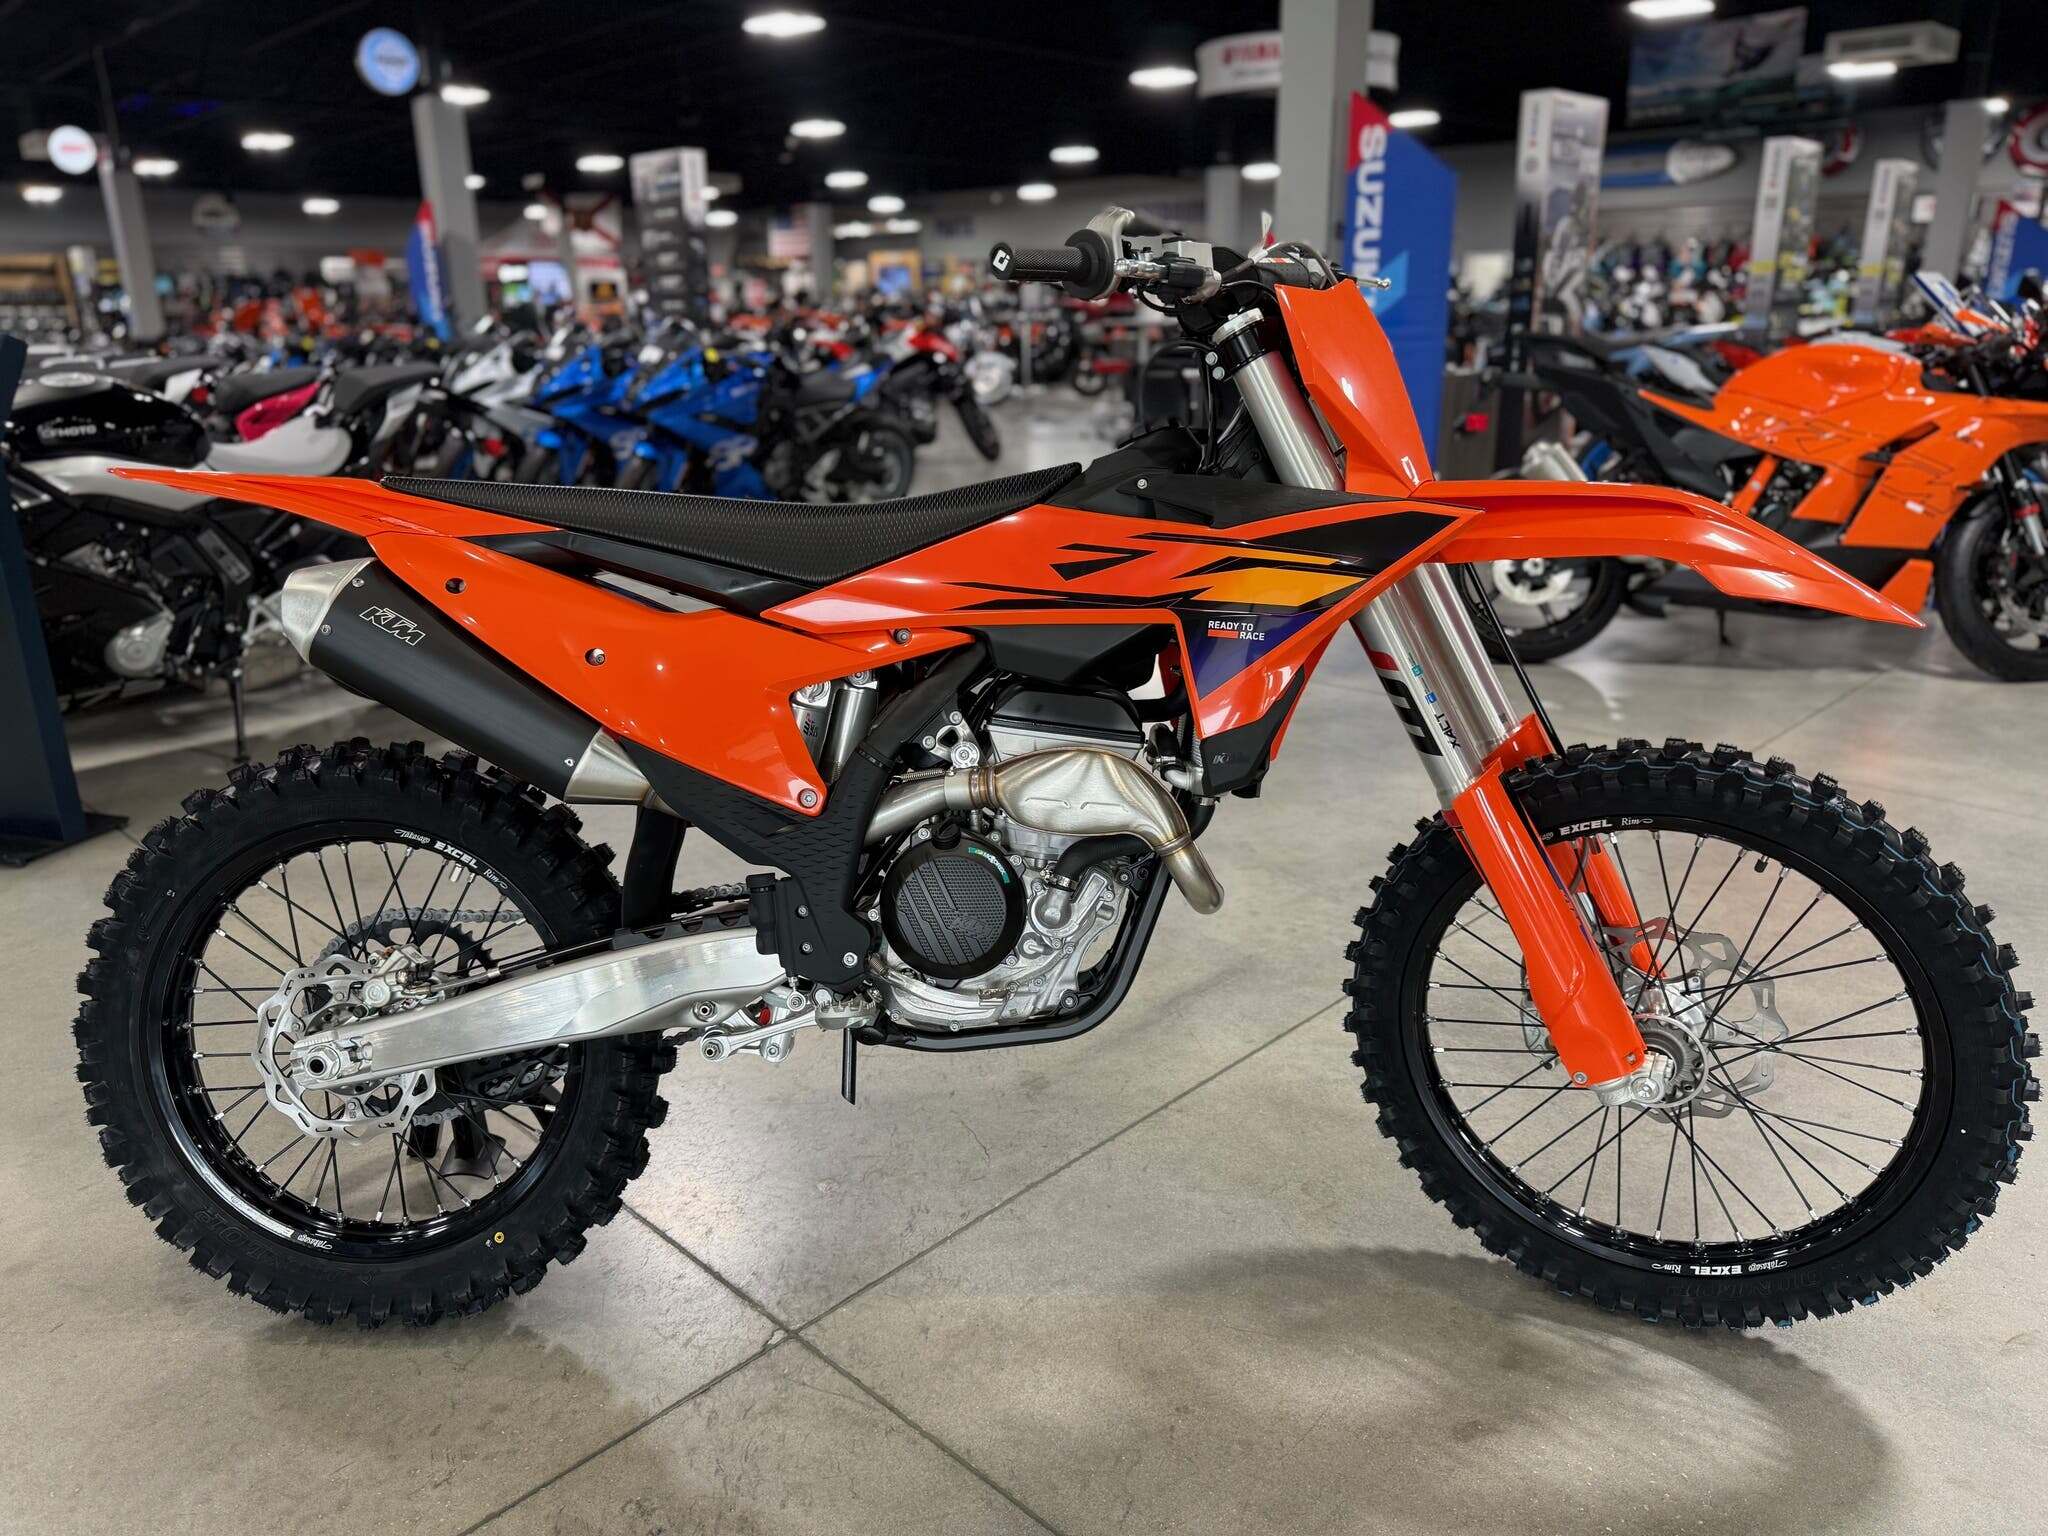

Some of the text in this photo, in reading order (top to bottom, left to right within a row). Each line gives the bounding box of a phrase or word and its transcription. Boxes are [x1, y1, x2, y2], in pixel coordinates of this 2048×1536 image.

[1353, 123, 1388, 308] SUZUK
[359, 605, 426, 646] KTM
[1208, 620, 1254, 632] READY TO
[1240, 631, 1266, 641] RACE
[1434, 713, 1461, 749] XACT
[1559, 819, 1613, 836] EXCEL
[1621, 816, 1648, 827] Rim
[433, 840, 478, 869] EXCEL
[1657, 1263, 1682, 1274] Rim
[1690, 1264, 1742, 1276] EXCEL
